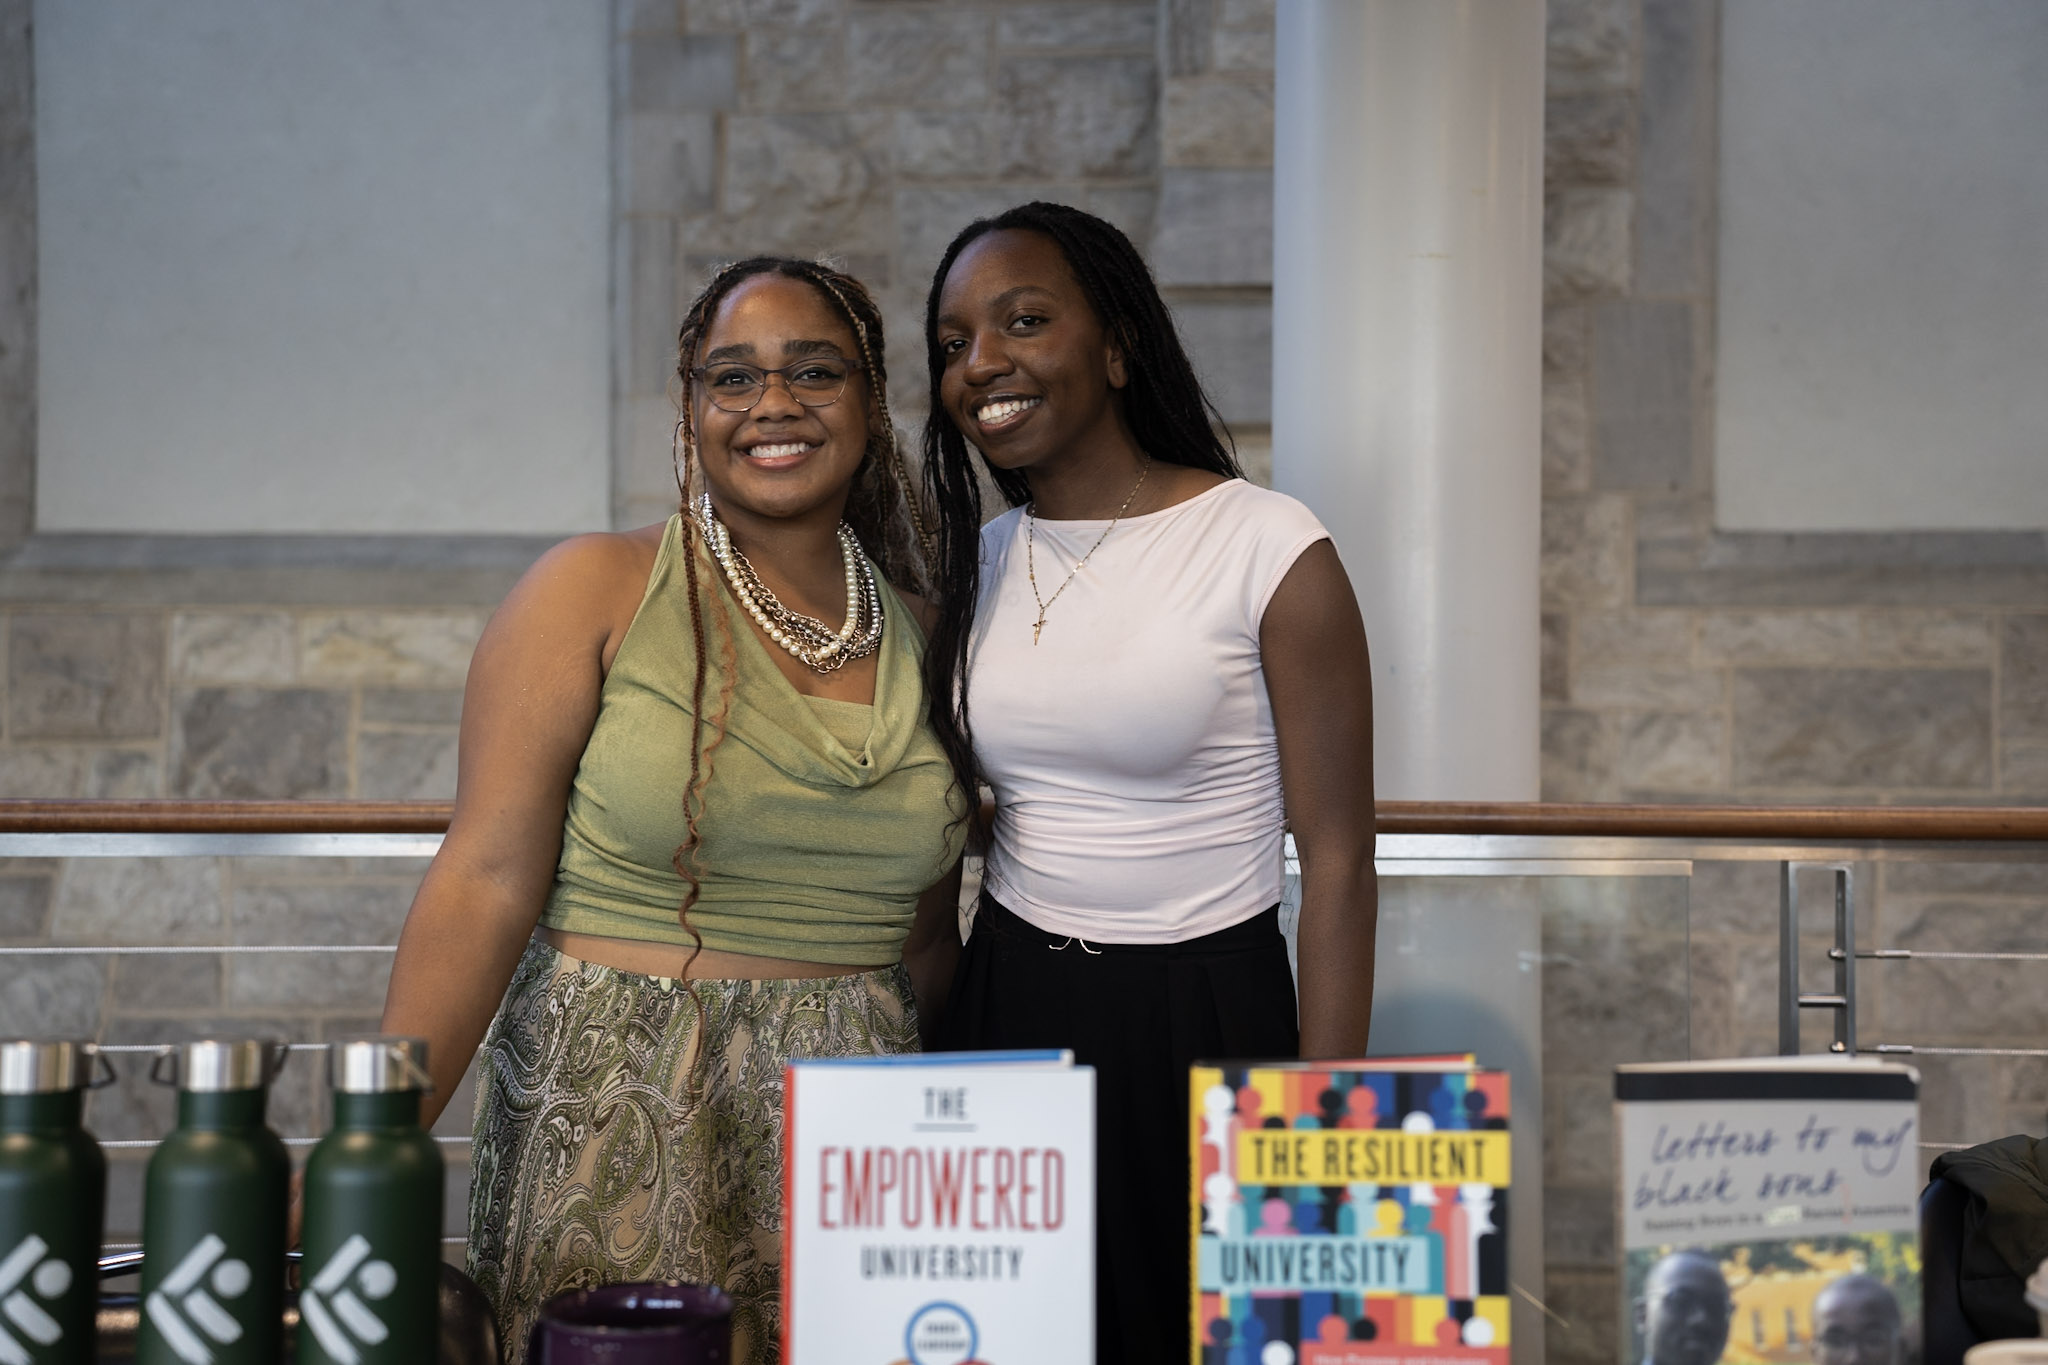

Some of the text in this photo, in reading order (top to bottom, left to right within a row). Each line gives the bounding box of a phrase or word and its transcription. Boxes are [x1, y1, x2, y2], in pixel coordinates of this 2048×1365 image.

[923, 1087, 969, 1120] THE
[1252, 1136, 1488, 1179] THE RESILIENT
[1851, 1117, 1914, 1177] my
[818, 1146, 1066, 1231] EMPOWERED
[1632, 1167, 1738, 1211] black
[860, 1245, 1024, 1281] UNIVERSITY
[1219, 1242, 1413, 1285] UNIVERSITY
